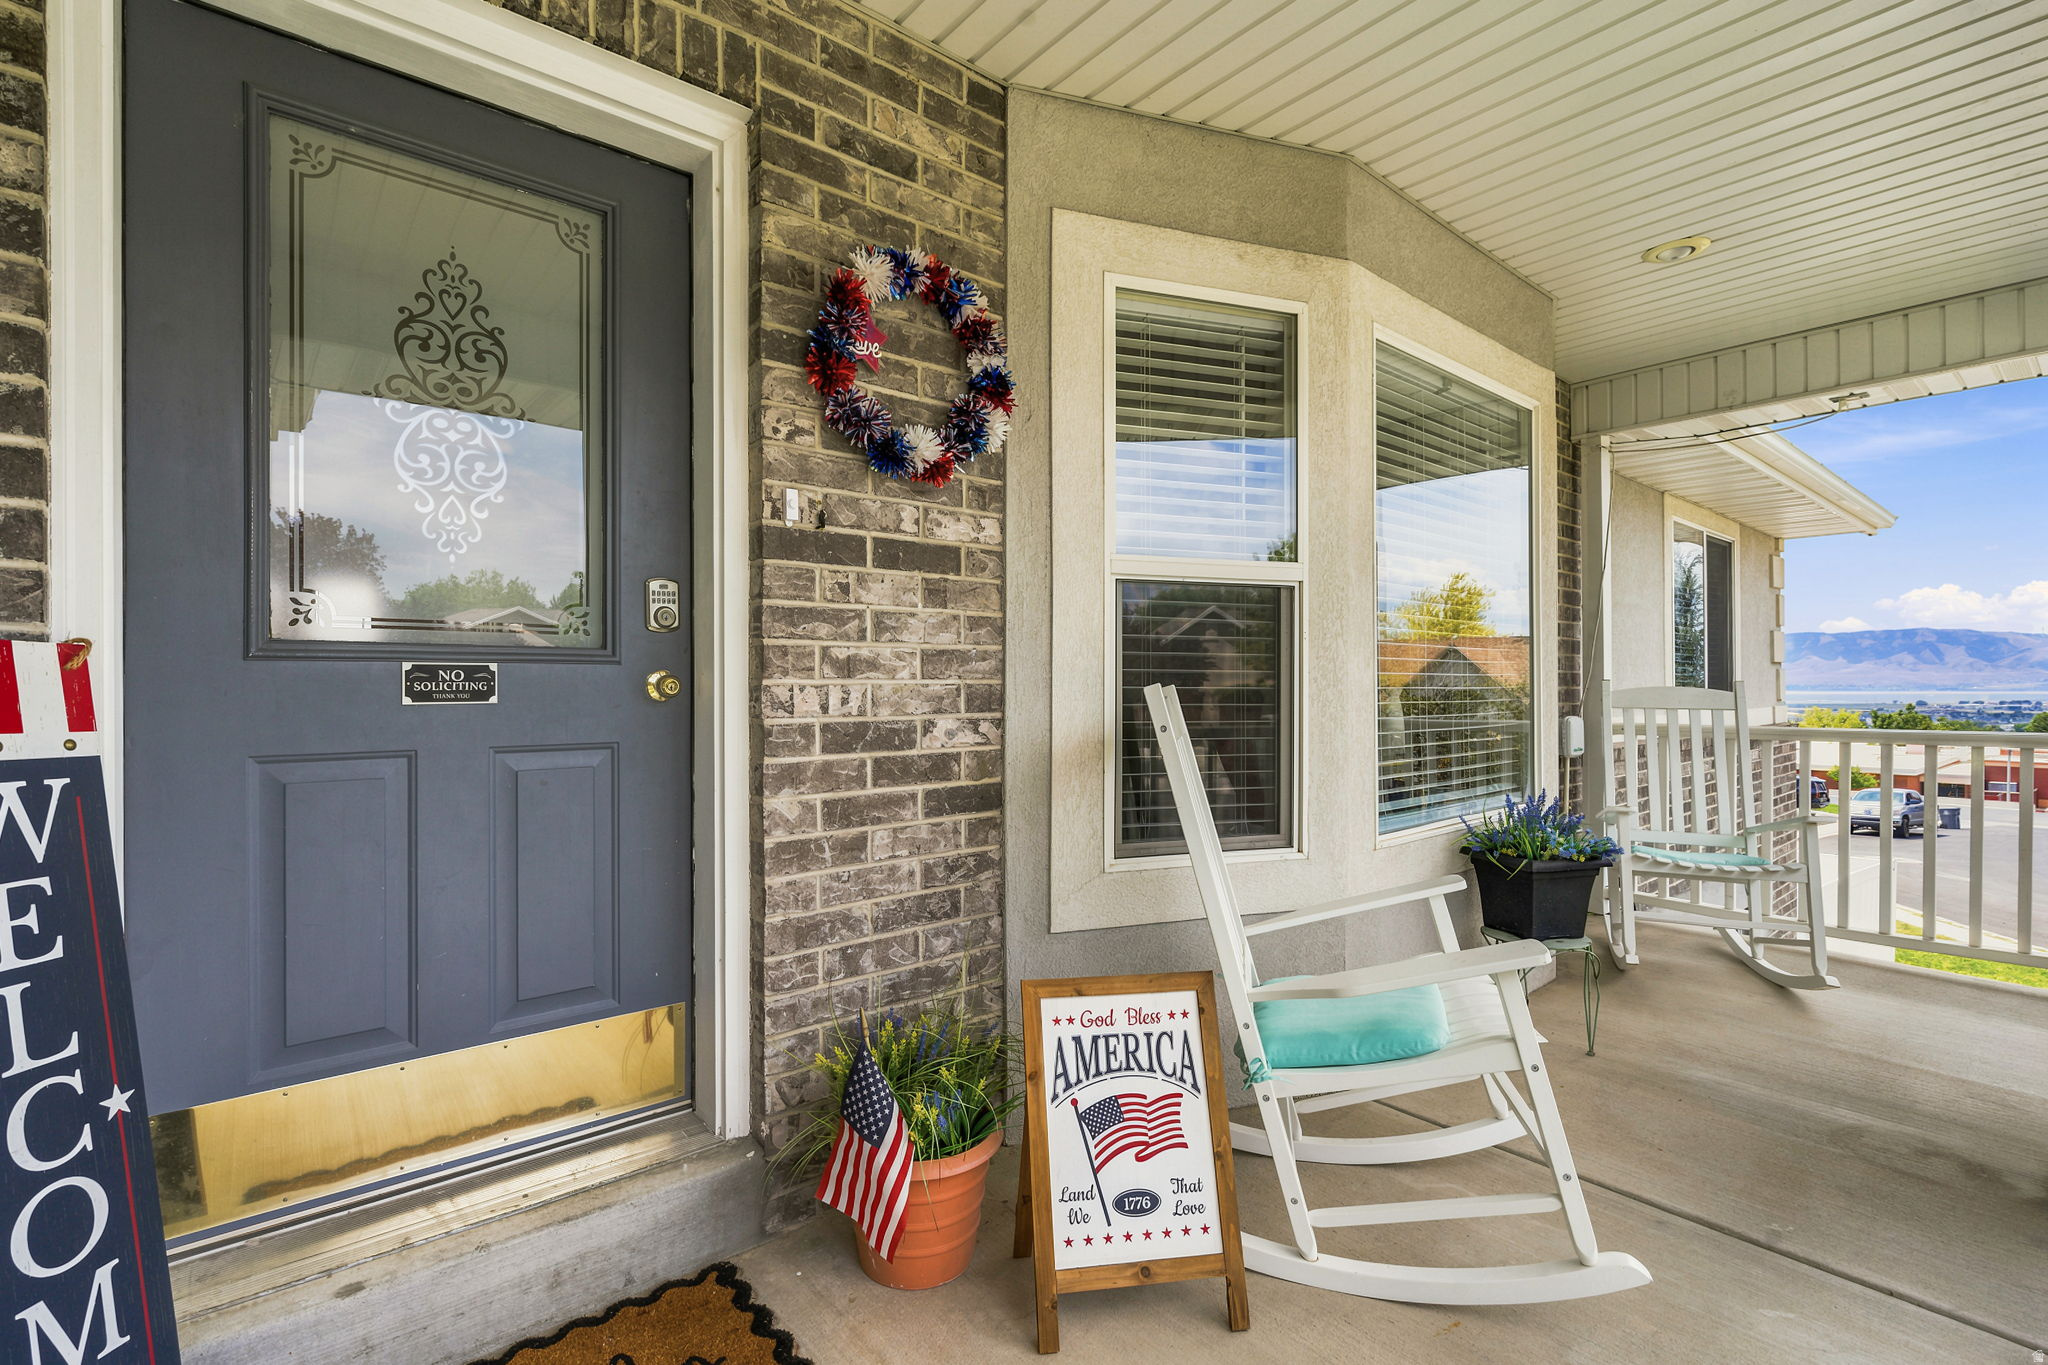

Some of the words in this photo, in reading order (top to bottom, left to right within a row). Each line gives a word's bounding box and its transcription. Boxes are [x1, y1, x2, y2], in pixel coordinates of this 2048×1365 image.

[438, 669, 465, 682] NO
[413, 681, 488, 691] SOLICITING
[1080, 1009, 1116, 1028] God
[1124, 1007, 1162, 1026] Bless
[1050, 1030, 1201, 1104] AMERICA
[1058, 1184, 1096, 1203] Land
[1170, 1177, 1204, 1194] That
[1123, 1197, 1151, 1211] 1776
[1172, 1200, 1206, 1218] Love
[1067, 1207, 1091, 1225] We
